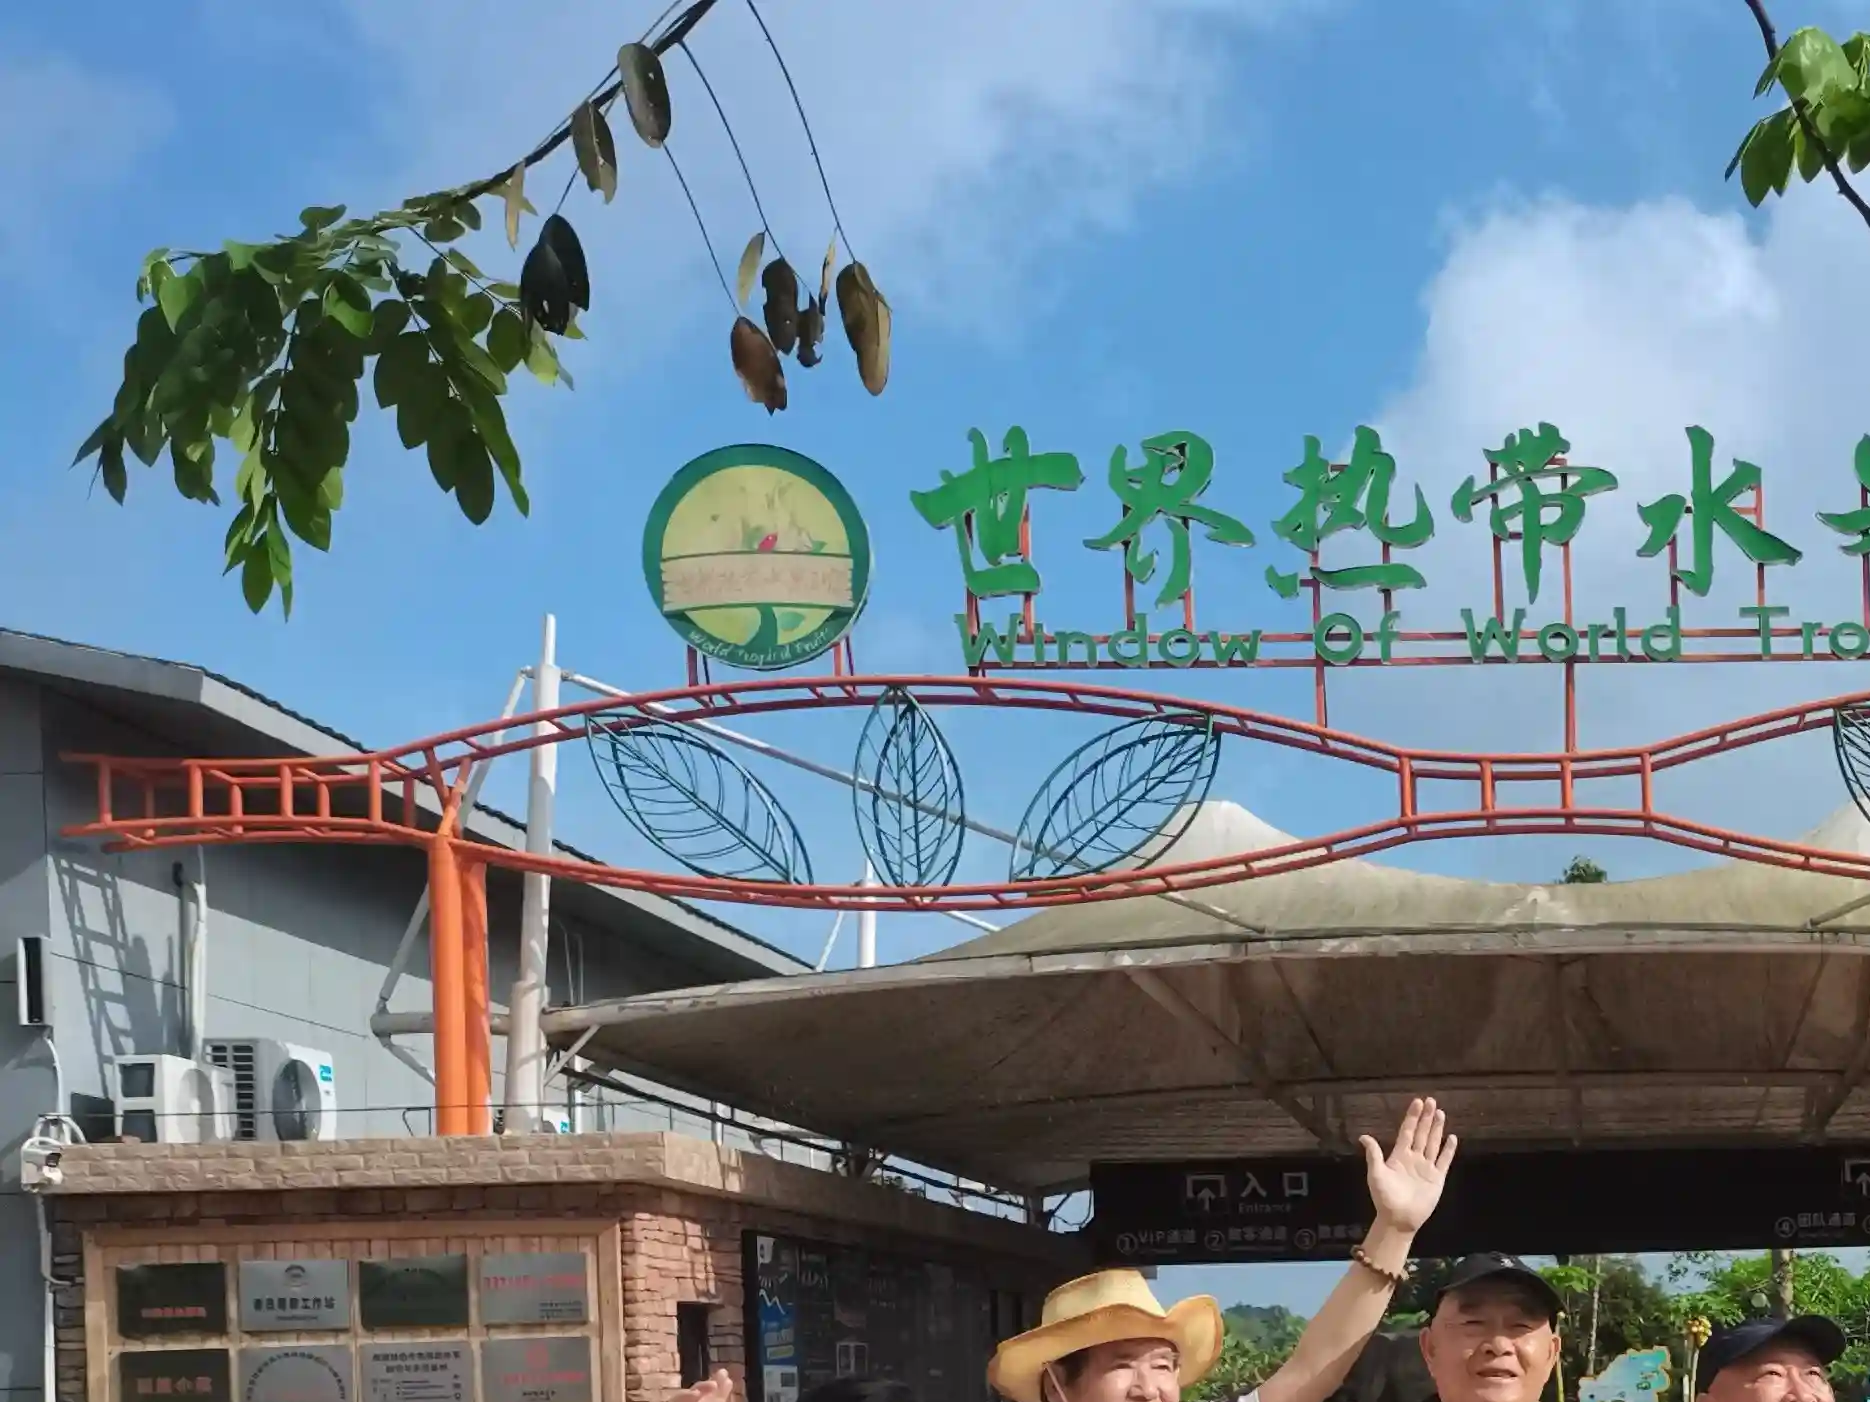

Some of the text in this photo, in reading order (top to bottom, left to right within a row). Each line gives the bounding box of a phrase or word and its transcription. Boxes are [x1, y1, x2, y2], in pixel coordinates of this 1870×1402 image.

[954, 612, 1262, 668] Window
[1313, 610, 1400, 666] Of
[1460, 605, 1682, 664] World
[1240, 1171, 1309, 1198] 入口
